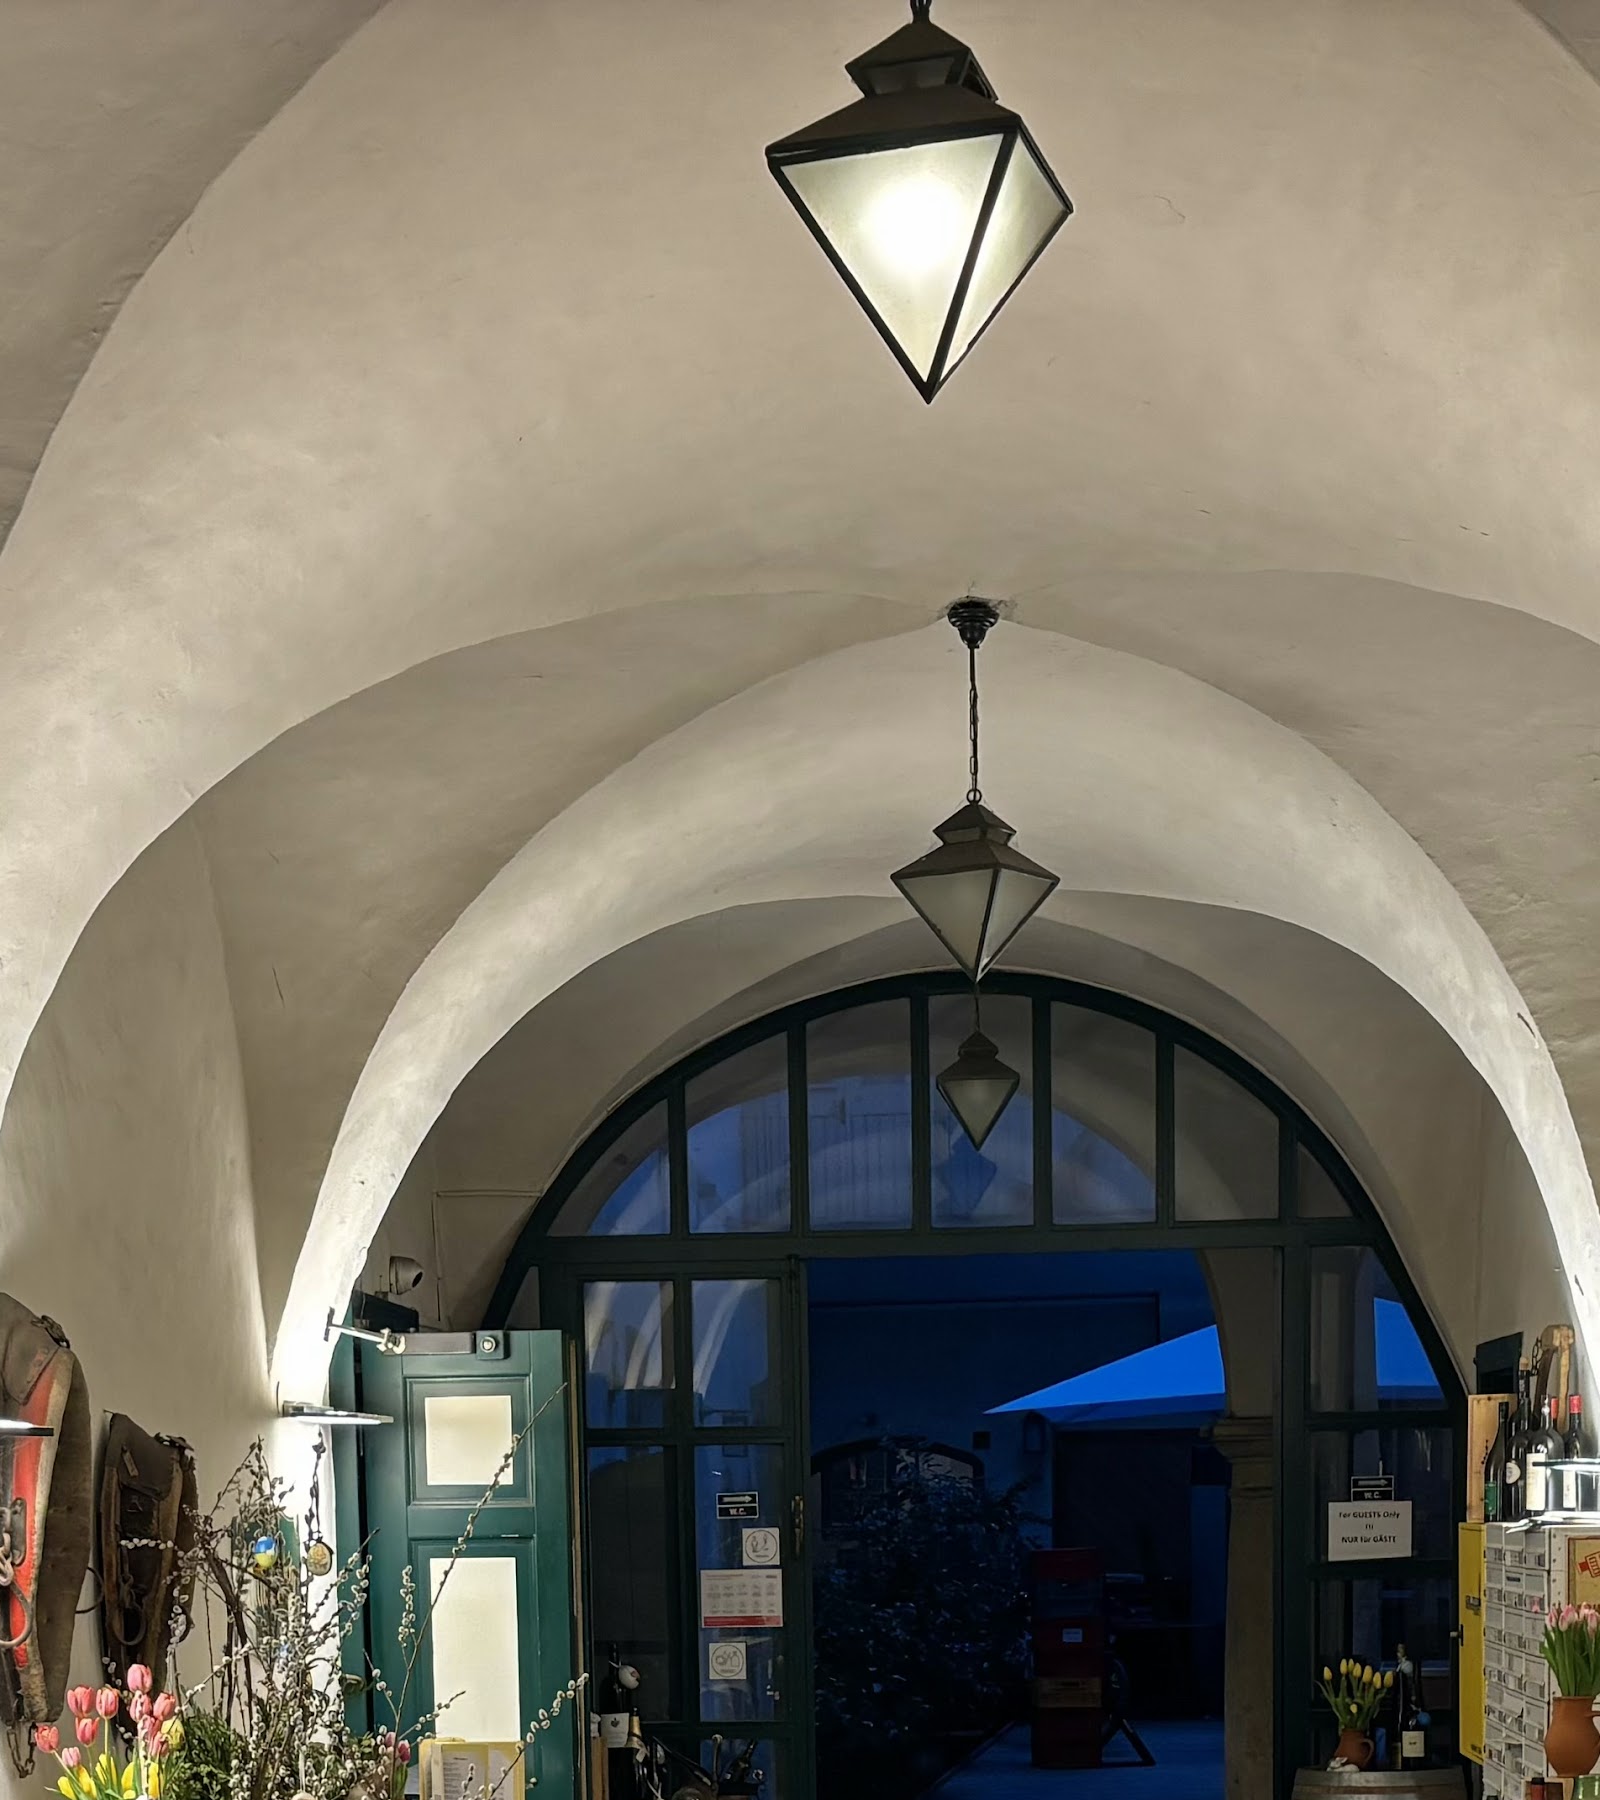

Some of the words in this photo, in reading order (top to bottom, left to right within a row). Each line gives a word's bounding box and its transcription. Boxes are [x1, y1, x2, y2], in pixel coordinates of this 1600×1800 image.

[1339, 1511, 1351, 1519] For
[1352, 1511, 1381, 1519] GUESTS
[1382, 1510, 1401, 1520] Only
[1341, 1536, 1359, 1544] NUR
